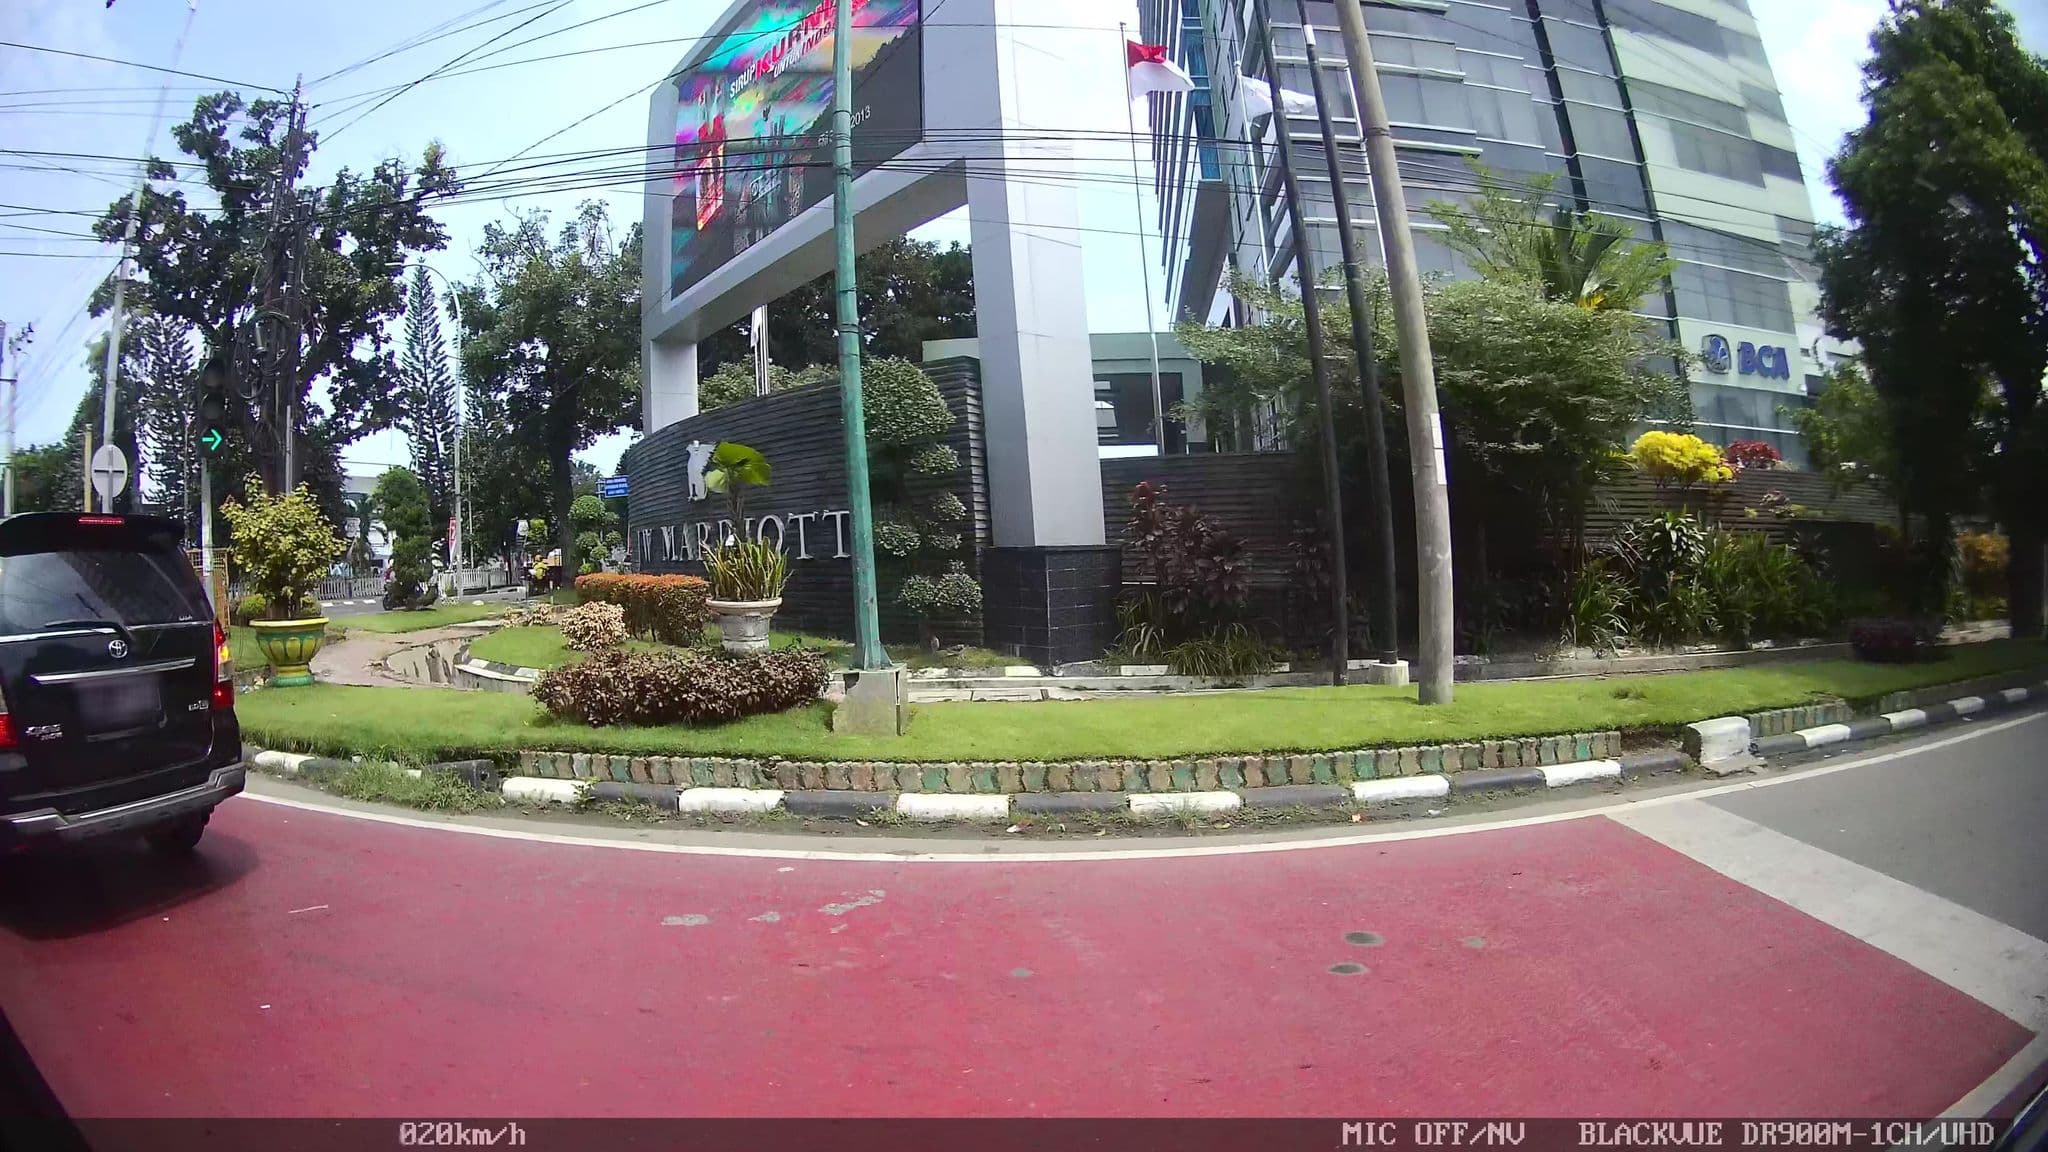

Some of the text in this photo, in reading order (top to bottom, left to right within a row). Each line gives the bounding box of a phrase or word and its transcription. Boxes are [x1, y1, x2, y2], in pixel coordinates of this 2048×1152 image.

[729, 0, 837, 99] SIRUP KURNI
[773, 49, 801, 78] UNTUK
[850, 104, 872, 129] 2013
[1737, 341, 1790, 380] BCA
